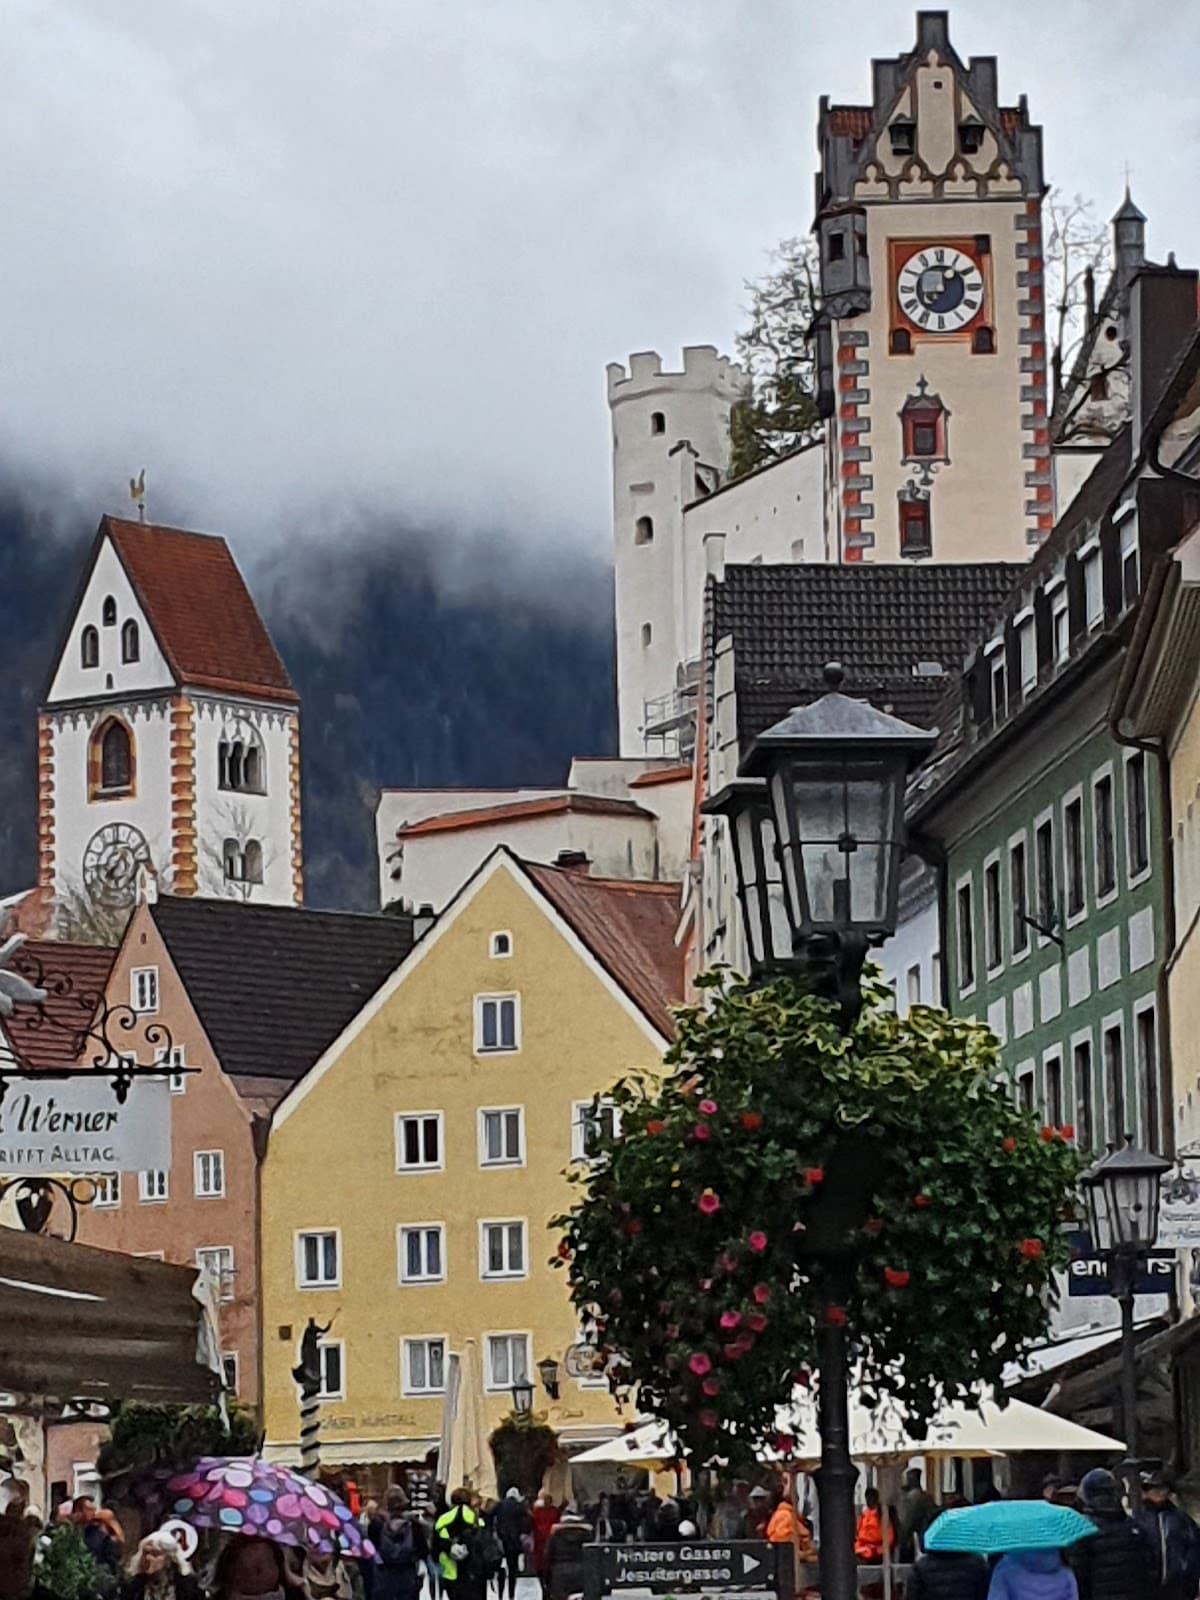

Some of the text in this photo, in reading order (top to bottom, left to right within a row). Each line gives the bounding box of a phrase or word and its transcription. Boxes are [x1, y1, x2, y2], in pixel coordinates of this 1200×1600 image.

[10, 1094, 118, 1132] Werner
[1071, 1258, 1172, 1278] enrs
[680, 1546, 731, 1561] Gasse
